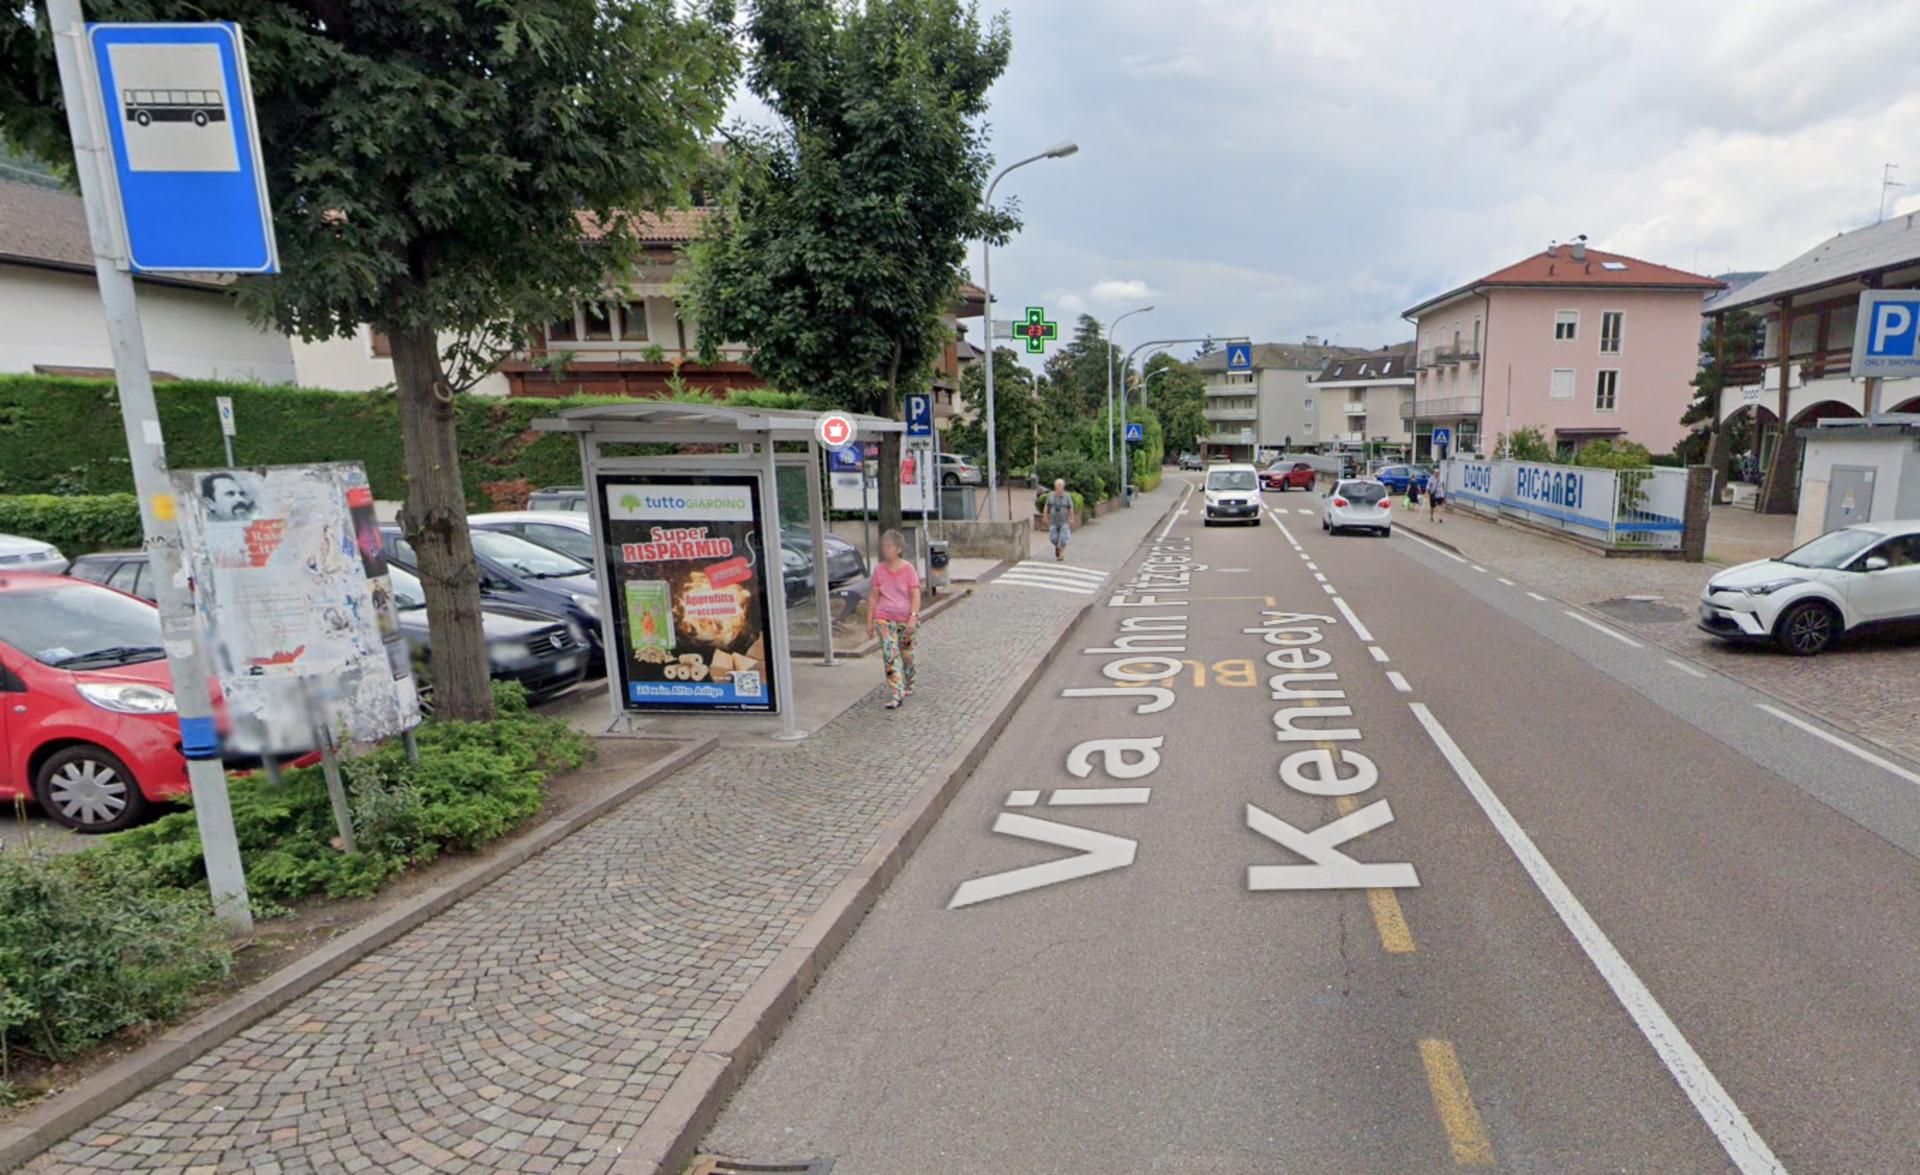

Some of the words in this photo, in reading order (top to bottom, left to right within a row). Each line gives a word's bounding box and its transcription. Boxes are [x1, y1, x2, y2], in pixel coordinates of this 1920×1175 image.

[1873, 305, 1911, 352] P
[911, 397, 925, 420] P
[1517, 466, 1584, 509] RICAMBI
[651, 527, 708, 545] Super
[622, 538, 733, 562] RISPARMIO
